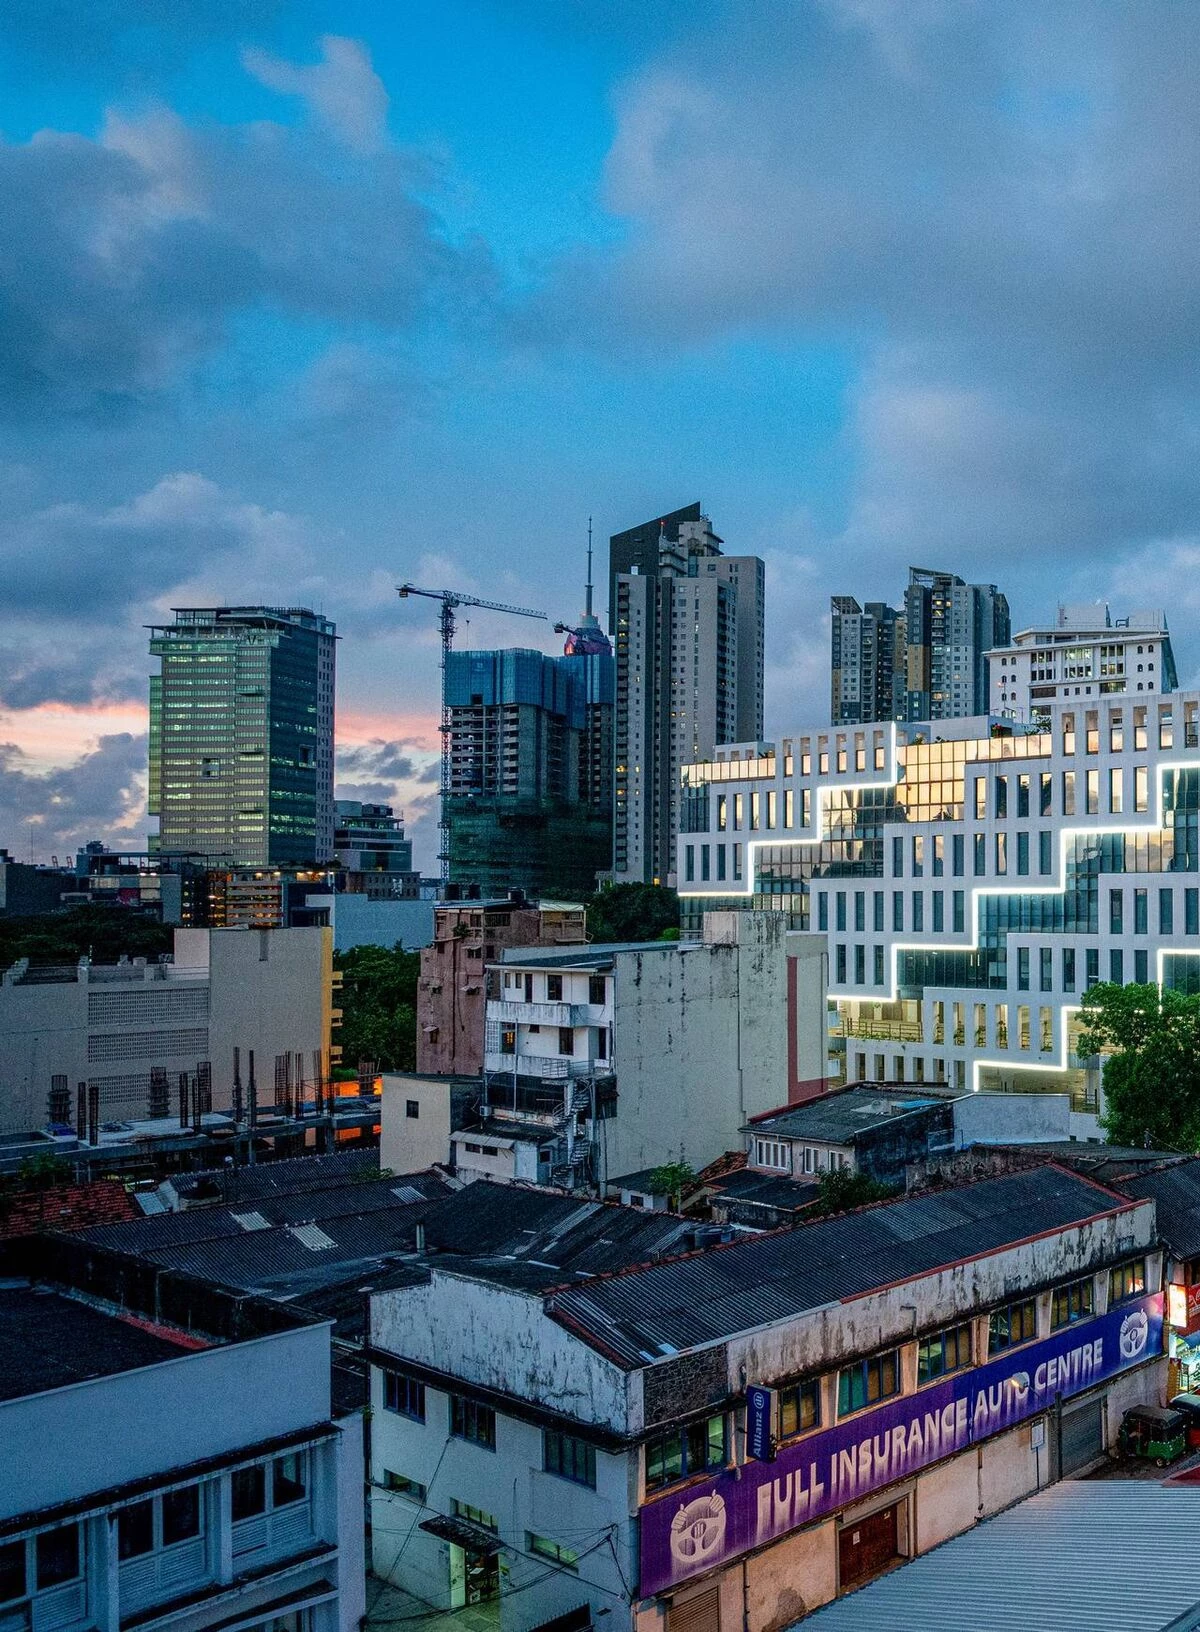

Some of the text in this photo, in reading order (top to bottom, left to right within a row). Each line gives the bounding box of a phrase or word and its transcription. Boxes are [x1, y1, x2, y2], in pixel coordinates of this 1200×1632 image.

[753, 1412, 762, 1457] Allianz
[757, 1462, 824, 1523] FULL
[831, 1397, 968, 1485] INSURANCE
[974, 1372, 1030, 1418] AUTO
[1035, 1338, 1104, 1390] CENTRE
